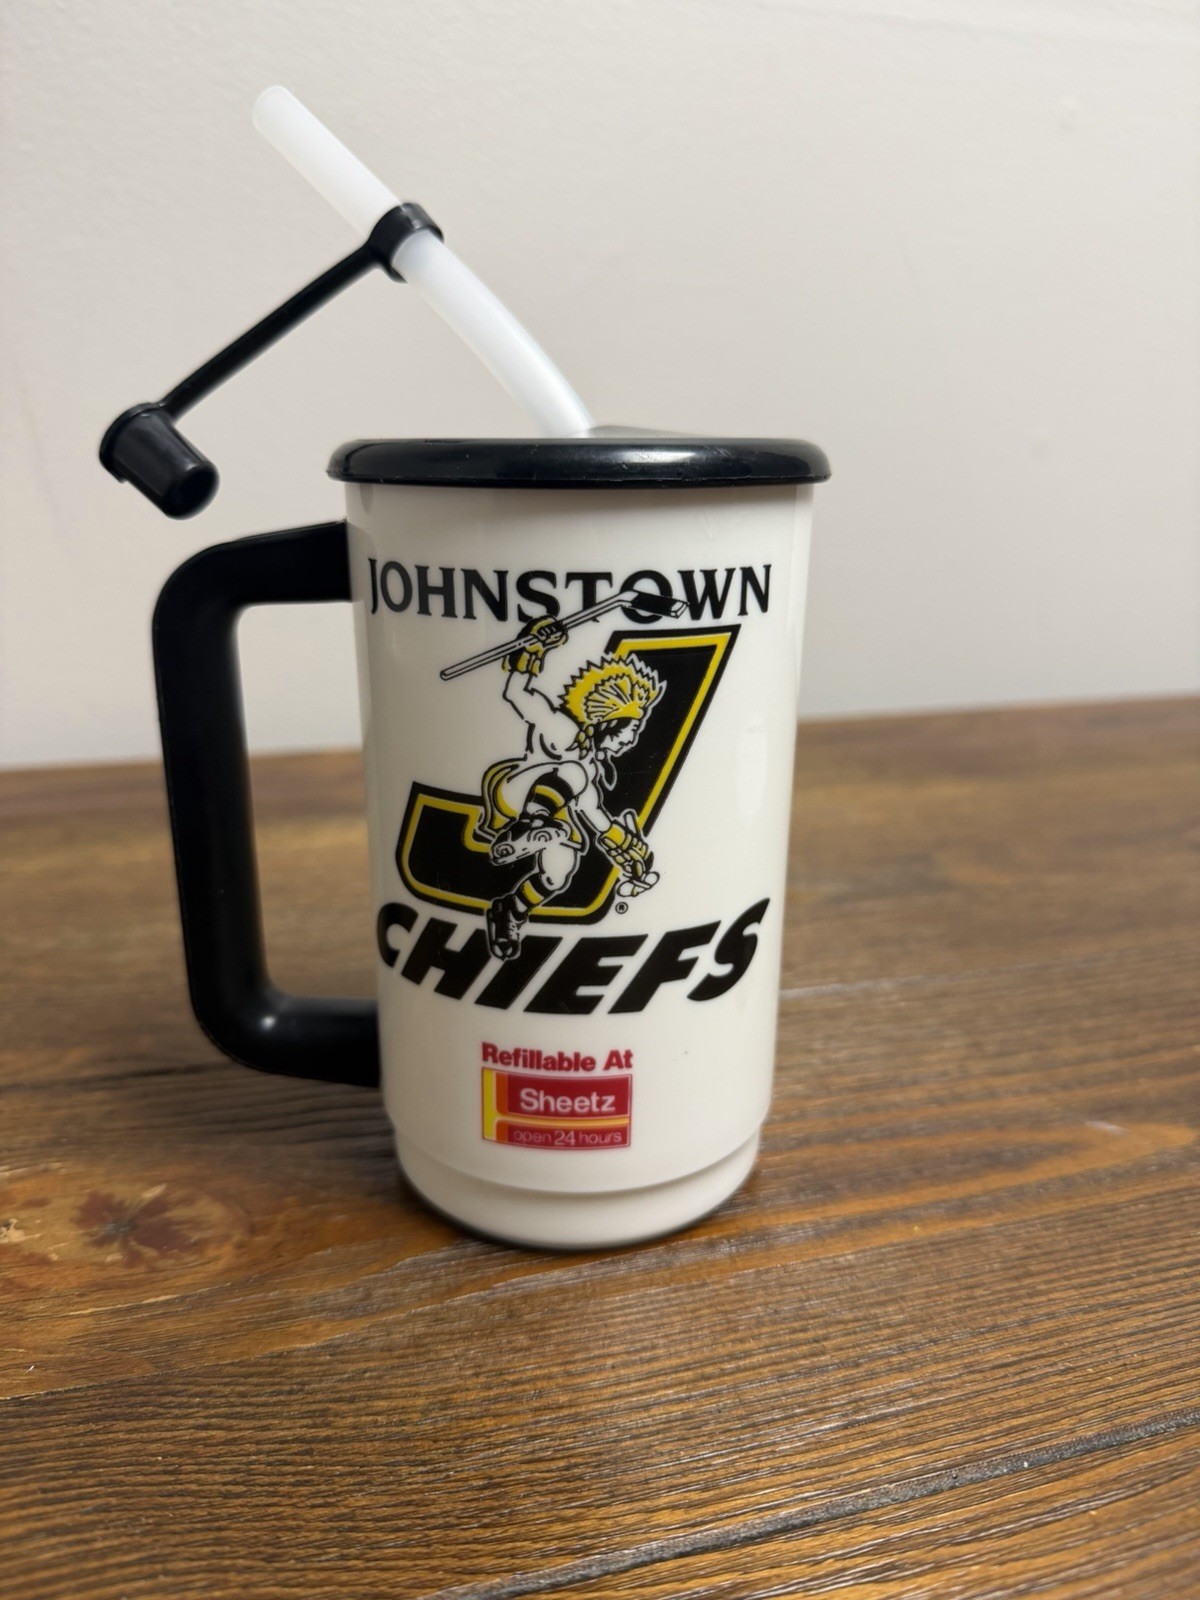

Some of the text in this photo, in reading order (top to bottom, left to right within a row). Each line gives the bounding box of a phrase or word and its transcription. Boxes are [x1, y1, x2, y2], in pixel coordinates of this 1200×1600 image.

[368, 557, 772, 624] JOHNSTOWN
[377, 897, 770, 1015] CHIEFS
[482, 1041, 634, 1072] Refillable At
[519, 1087, 616, 1113] Sheetz
[513, 1129, 622, 1146] open 24 hours
